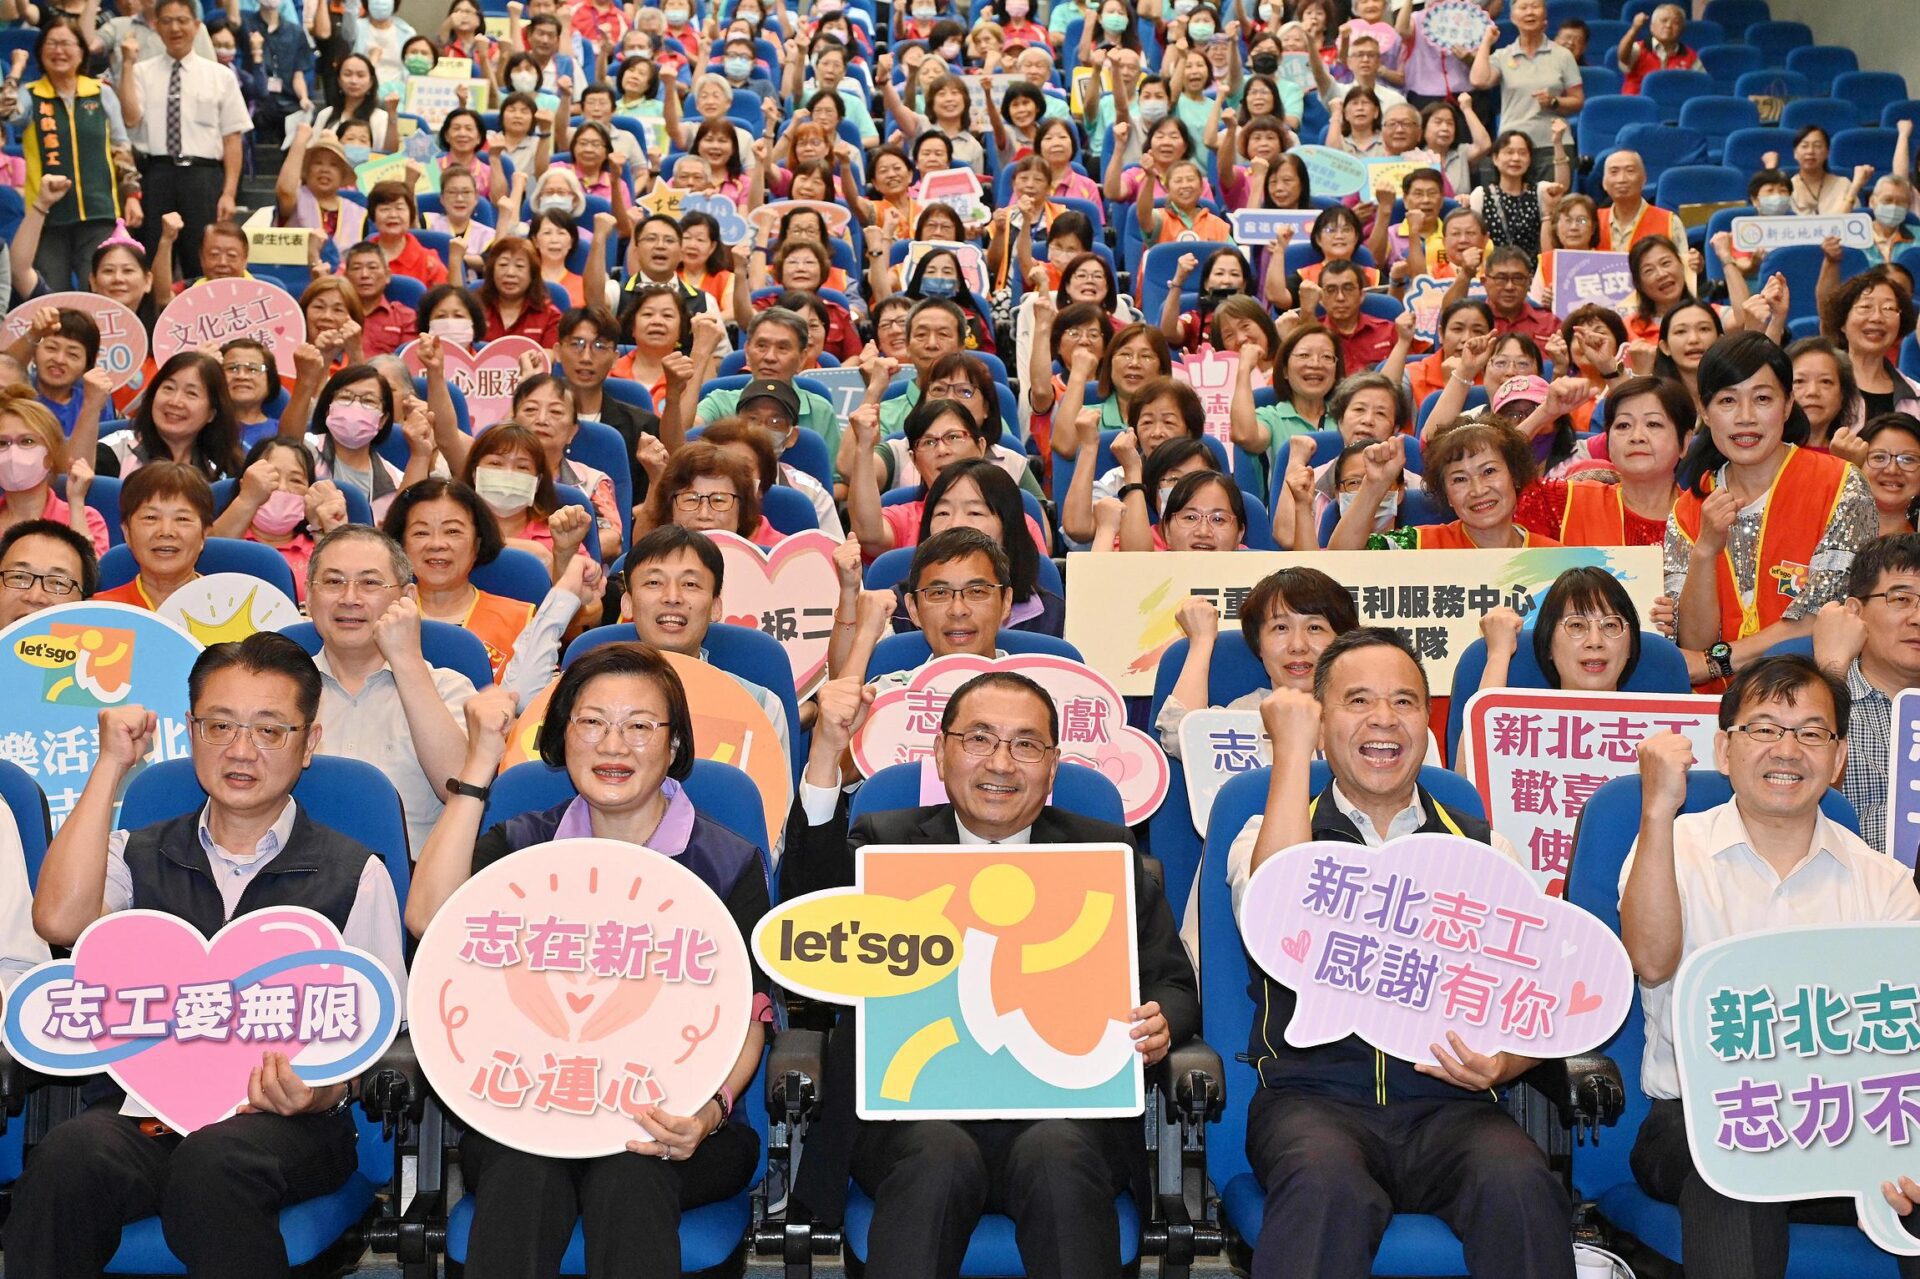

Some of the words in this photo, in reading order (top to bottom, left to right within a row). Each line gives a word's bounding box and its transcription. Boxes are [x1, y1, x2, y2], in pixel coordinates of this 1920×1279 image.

[168, 296, 280, 352] 文化志工
[19, 640, 77, 663] let'sgo
[1301, 856, 1545, 967] 新北志工
[458, 909, 715, 983] 志在新北
[779, 919, 955, 977] let'sgo
[44, 981, 360, 1041] 志工愛無限
[1314, 930, 1557, 1037] 感謝有你
[469, 1049, 664, 1117] 心連心
